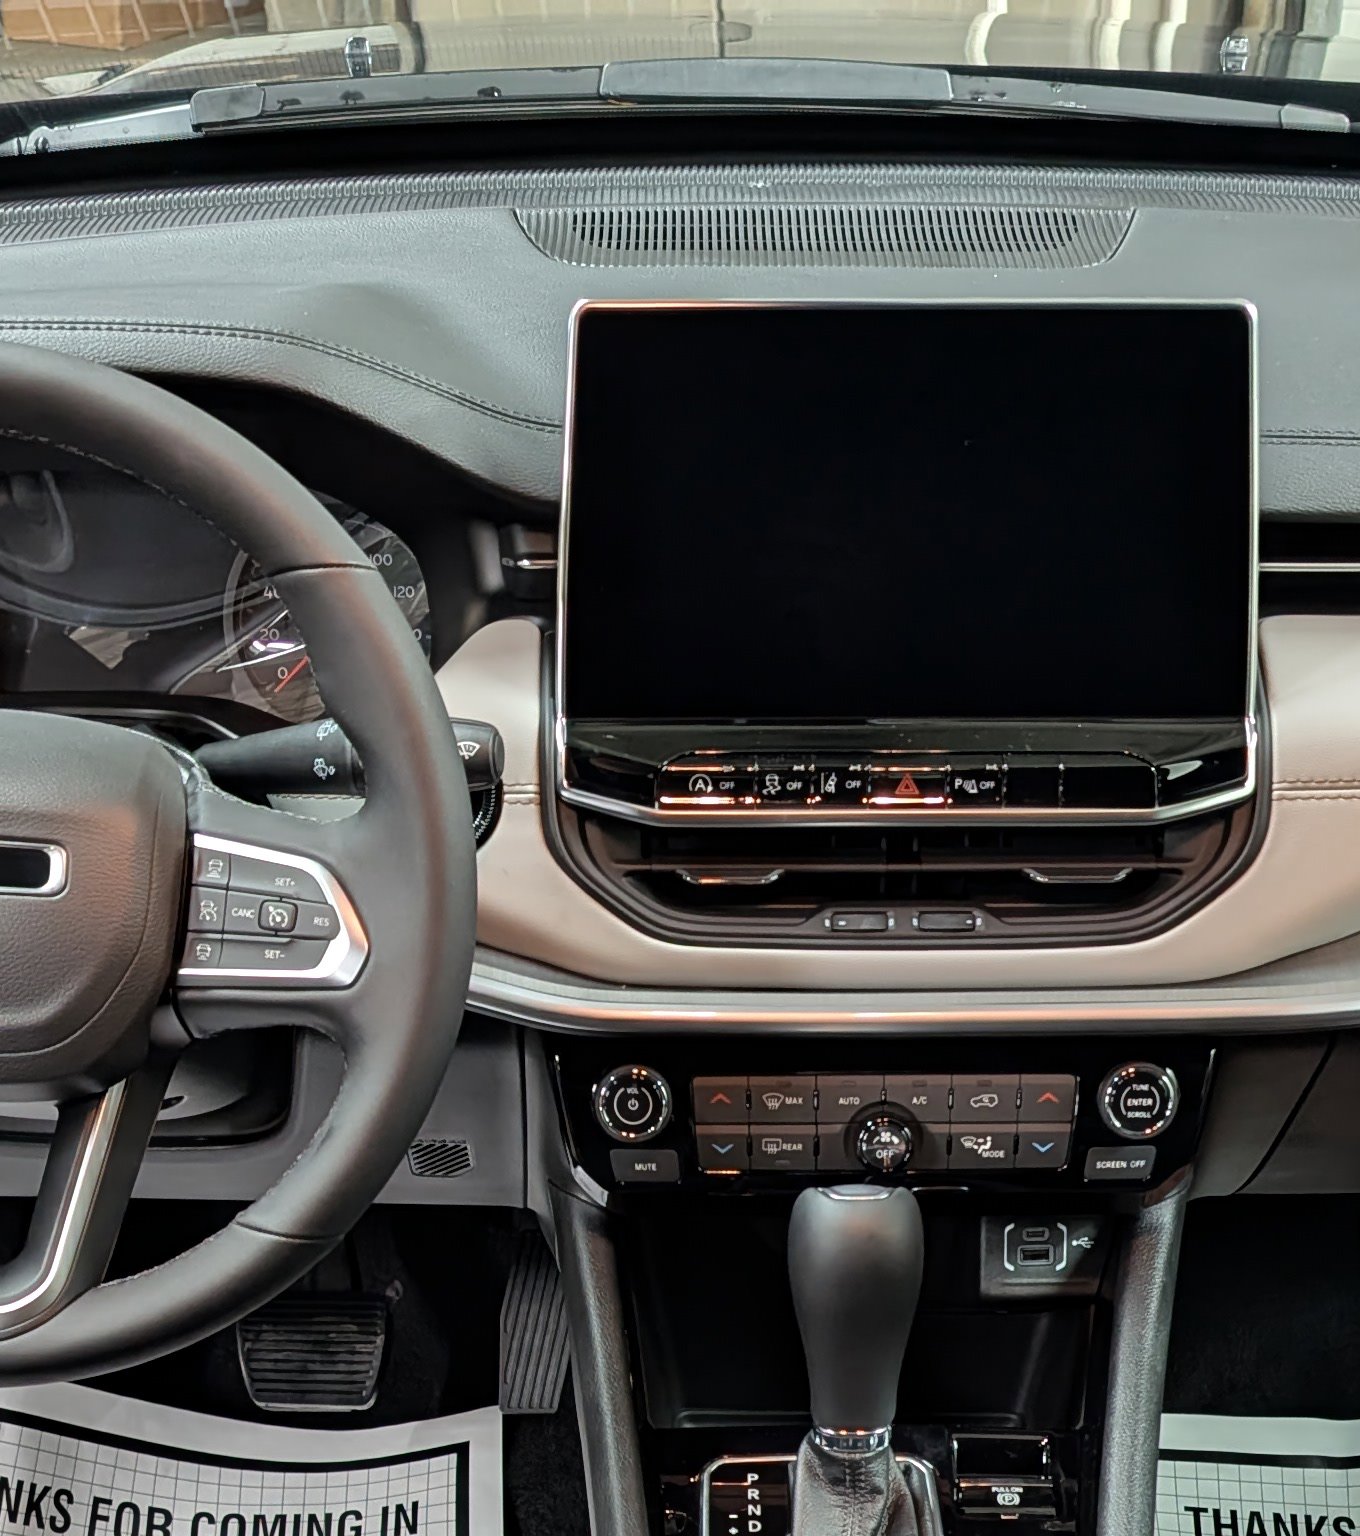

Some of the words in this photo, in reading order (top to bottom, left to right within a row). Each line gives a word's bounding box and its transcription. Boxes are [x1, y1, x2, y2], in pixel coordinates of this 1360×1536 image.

[393, 586, 415, 598] 120
[260, 628, 279, 641] 20
[278, 667, 288, 679] 0
[719, 781, 736, 790] OFF
[786, 781, 803, 790] OFF
[845, 780, 862, 789] OFF
[954, 779, 962, 789] P
[979, 780, 996, 790] OFF
[231, 908, 256, 919] CANC
[313, 917, 330, 926] RES
[785, 1097, 803, 1105] MAX
[839, 1097, 860, 1105] AUTO
[912, 1096, 927, 1105] A/C
[1127, 1098, 1153, 1106] ENTER
[782, 1143, 803, 1151] REAR
[876, 1150, 894, 1159] OFF
[982, 1150, 1005, 1158] MODE
[634, 1163, 656, 1171] MUTE
[1096, 1161, 1127, 1169] SCREEN
[1130, 1160, 1146, 1168] OFF
[747, 1473, 759, 1485] P
[748, 1488, 760, 1500] R
[748, 1504, 762, 1516] N
[748, 1520, 762, 1533] D
